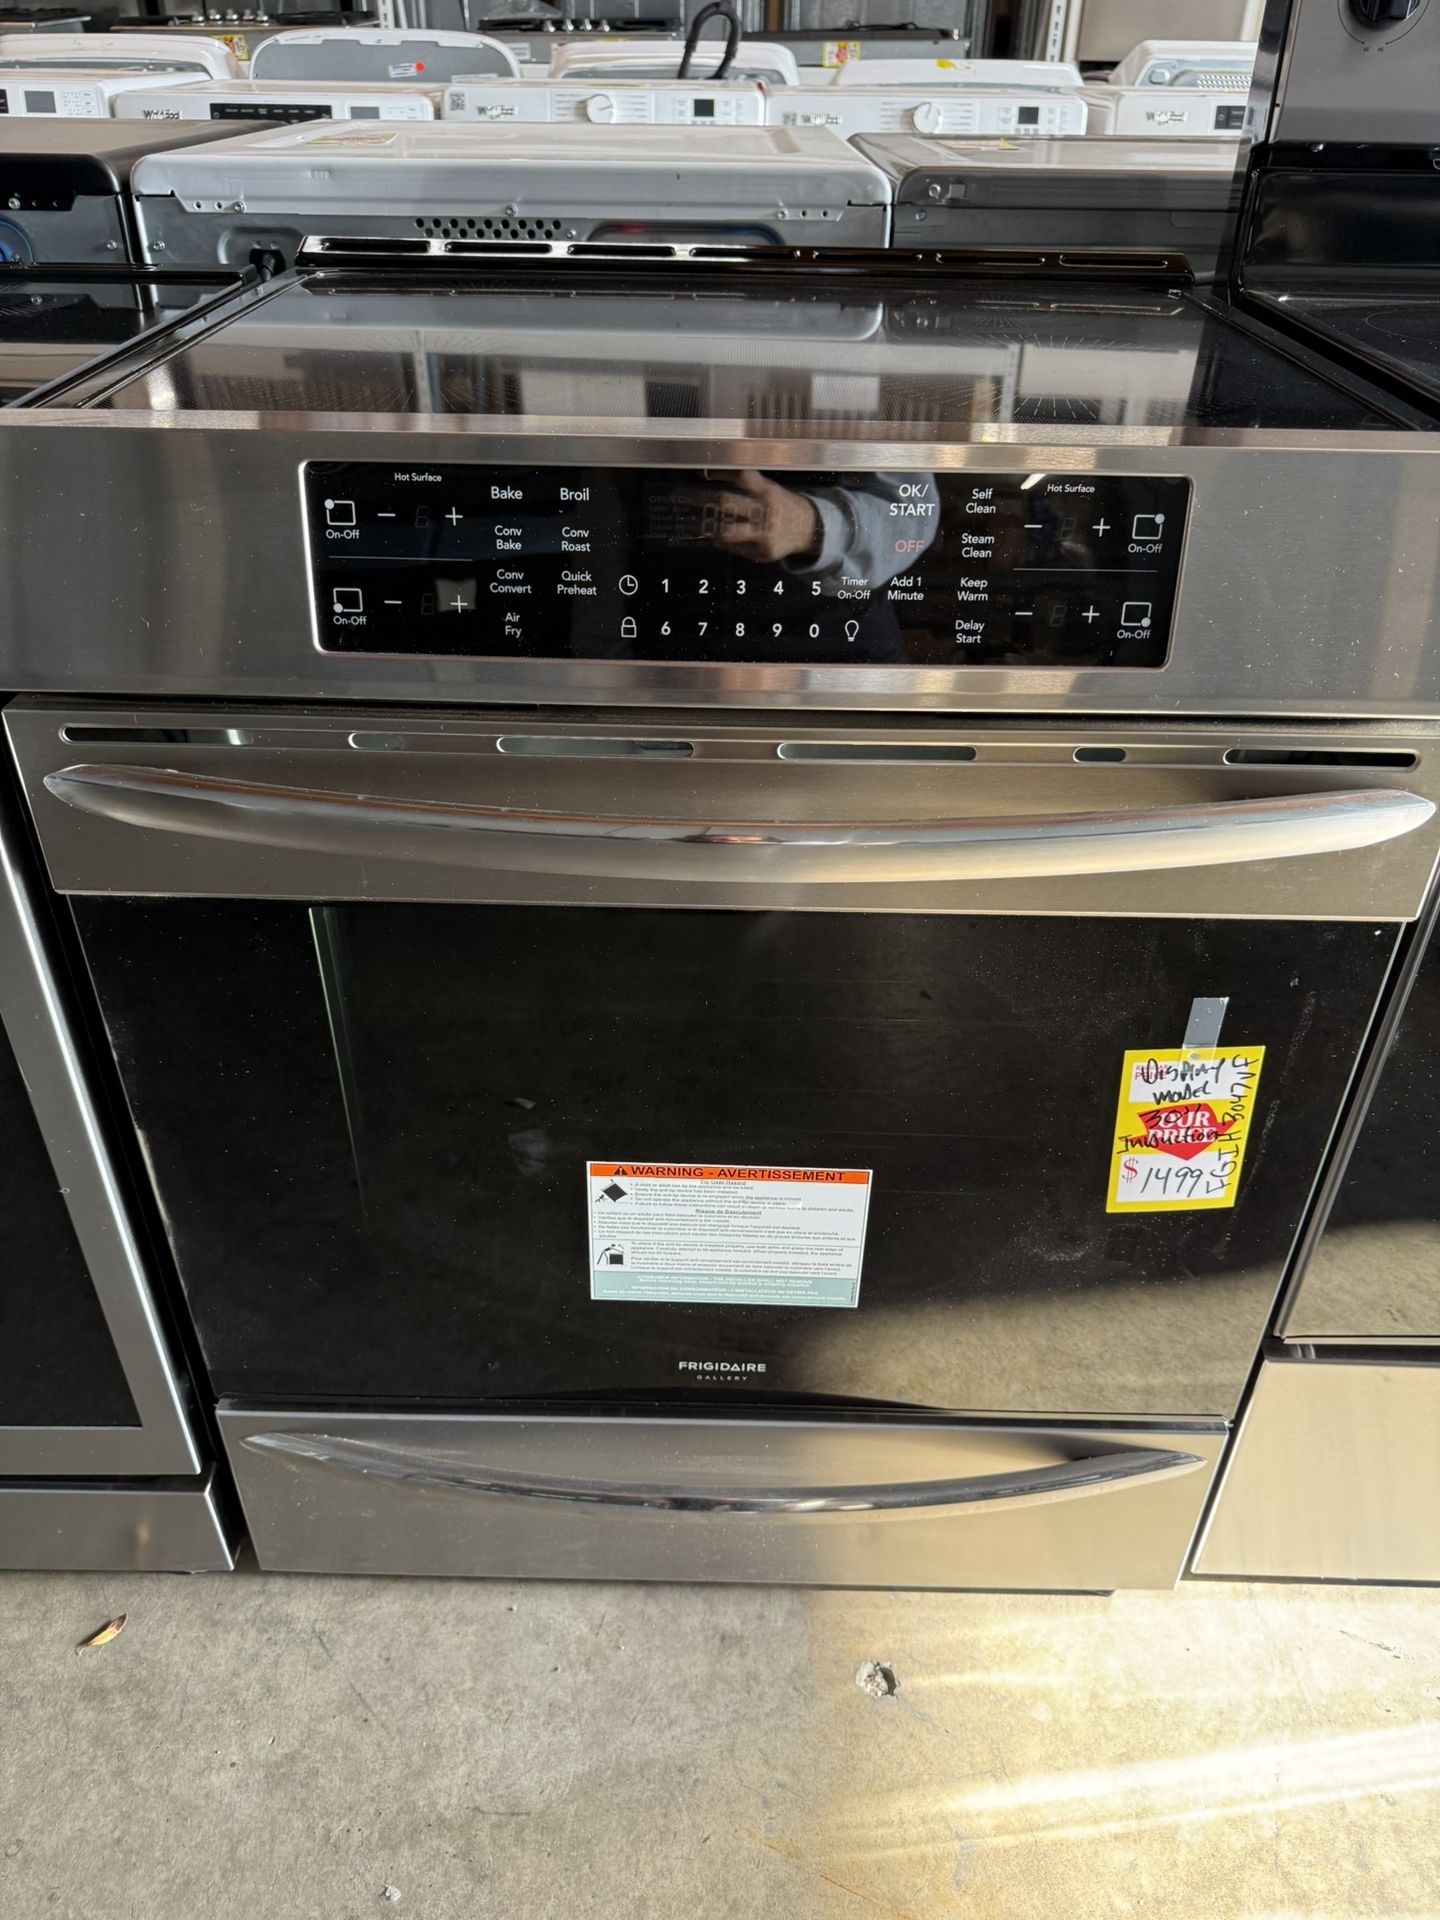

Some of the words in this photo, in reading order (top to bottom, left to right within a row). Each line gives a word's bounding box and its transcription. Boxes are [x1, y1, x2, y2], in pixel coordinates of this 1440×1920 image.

[395, 473, 414, 481] Hot
[414, 473, 441, 481] Surface
[491, 486, 522, 499] Bake
[899, 484, 928, 497] OK/
[1066, 484, 1095, 492] Surface
[561, 488, 589, 500] Broil
[972, 488, 993, 499] Self
[890, 504, 935, 515] START
[966, 503, 996, 513] Clean
[326, 529, 359, 539] On-Off
[495, 525, 522, 535] Conv
[562, 527, 589, 537] Conv
[962, 533, 994, 543] Steam
[497, 539, 521, 550] Bake
[562, 541, 590, 551] Roast
[895, 542, 924, 551] OFF
[1128, 544, 1162, 553] On-Off
[962, 547, 991, 557] Clean
[497, 569, 523, 579] Conv
[562, 571, 591, 581] Quick
[842, 576, 868, 586] Timer
[889, 575, 913, 586] Add
[917, 577, 921, 586] 1
[961, 577, 987, 590] Keep
[490, 583, 531, 593] Convert
[558, 584, 596, 595] Preheat
[662, 579, 668, 592] 1
[699, 579, 708, 593] 2
[737, 580, 745, 594] 3
[774, 581, 783, 594] 4
[812, 581, 821, 595] 5
[838, 590, 871, 599] On-Off
[888, 590, 924, 600] Minute
[958, 589, 988, 600] Warm
[334, 616, 366, 625] On-Off
[505, 613, 520, 621] Air
[505, 625, 521, 638] Fry
[661, 622, 670, 635] 6
[698, 622, 707, 635] 7
[736, 623, 744, 636] 8
[773, 624, 782, 637] 9
[810, 624, 819, 637] 0
[956, 620, 984, 634] Delay
[956, 633, 981, 643] Start
[1117, 630, 1150, 639] On-Off
[1159, 1111, 1210, 1128] OUR
[631, 1166, 704, 1176] WARNING
[717, 1169, 846, 1181] AVERTISSEMENT
[1140, 1166, 1203, 1198] 1499
[679, 1361, 766, 1372] FRIGIDAIRE
